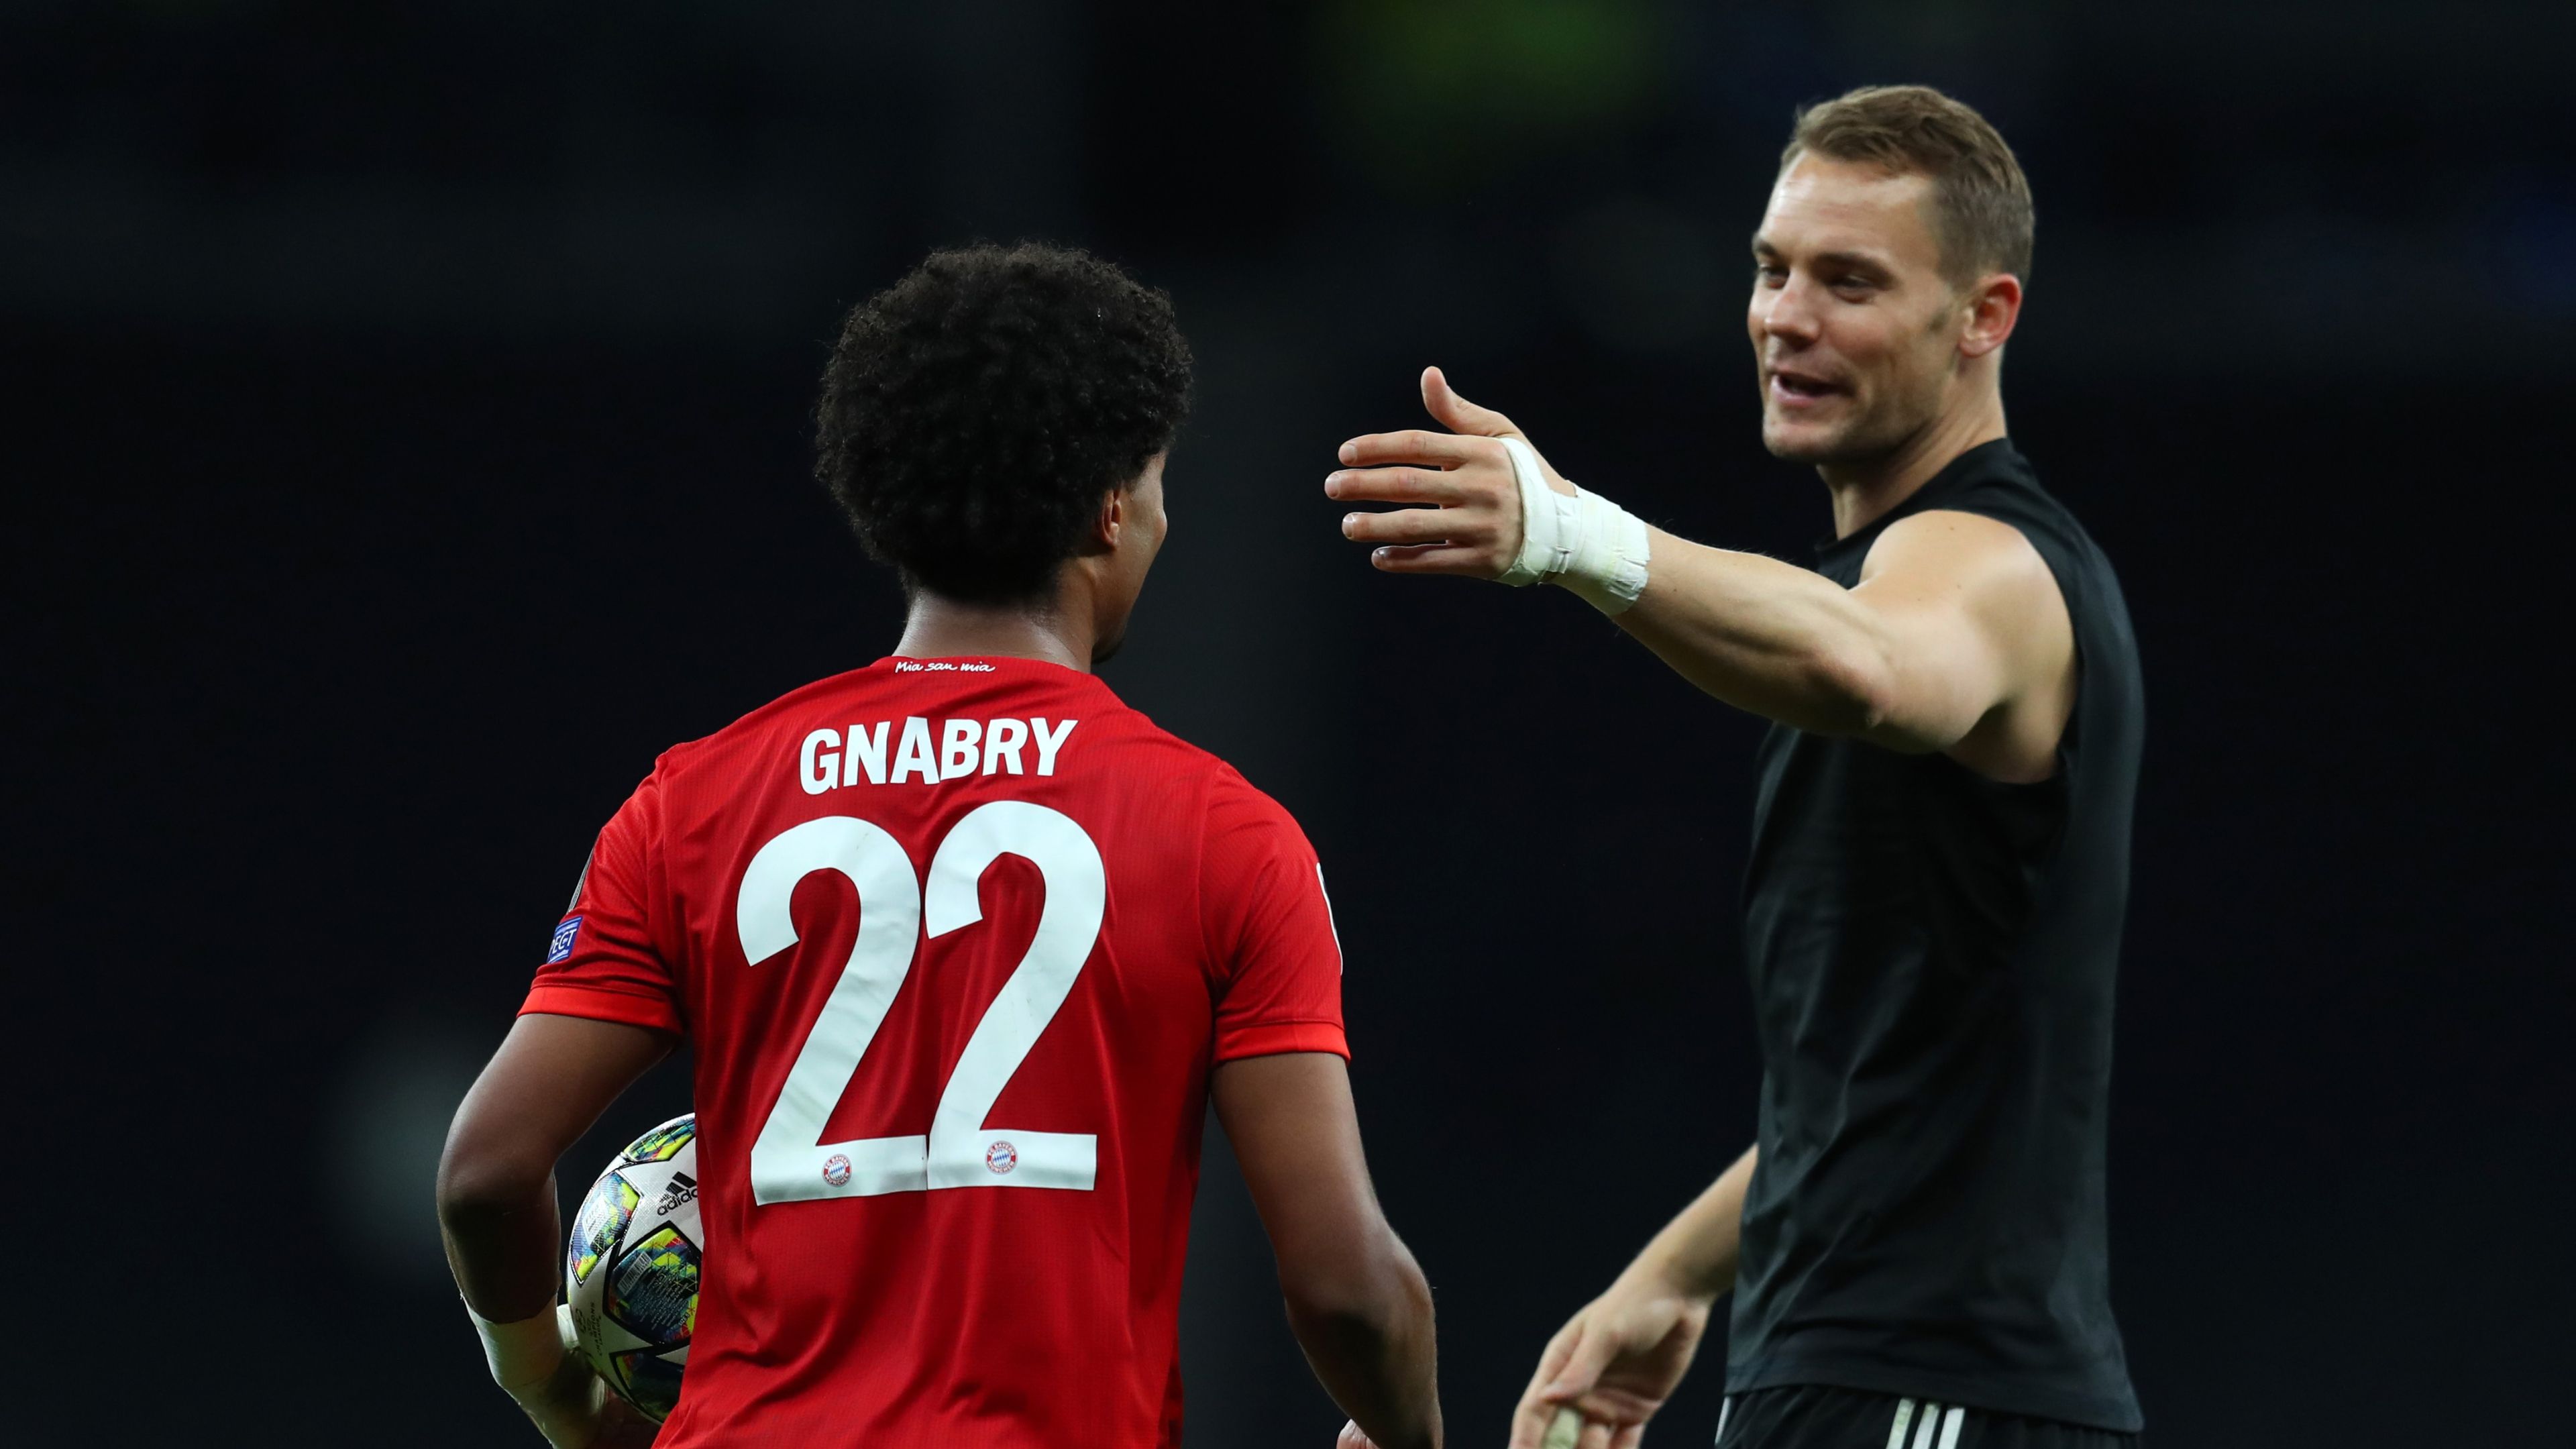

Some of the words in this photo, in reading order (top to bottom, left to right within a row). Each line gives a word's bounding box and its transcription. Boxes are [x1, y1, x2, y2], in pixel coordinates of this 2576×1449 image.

[895, 661, 924, 673] Mia
[924, 662, 958, 672] san
[960, 661, 996, 672] mia
[800, 716, 1079, 795] GNABRY
[737, 800, 1106, 1206] 22
[657, 1189, 698, 1216] adida
